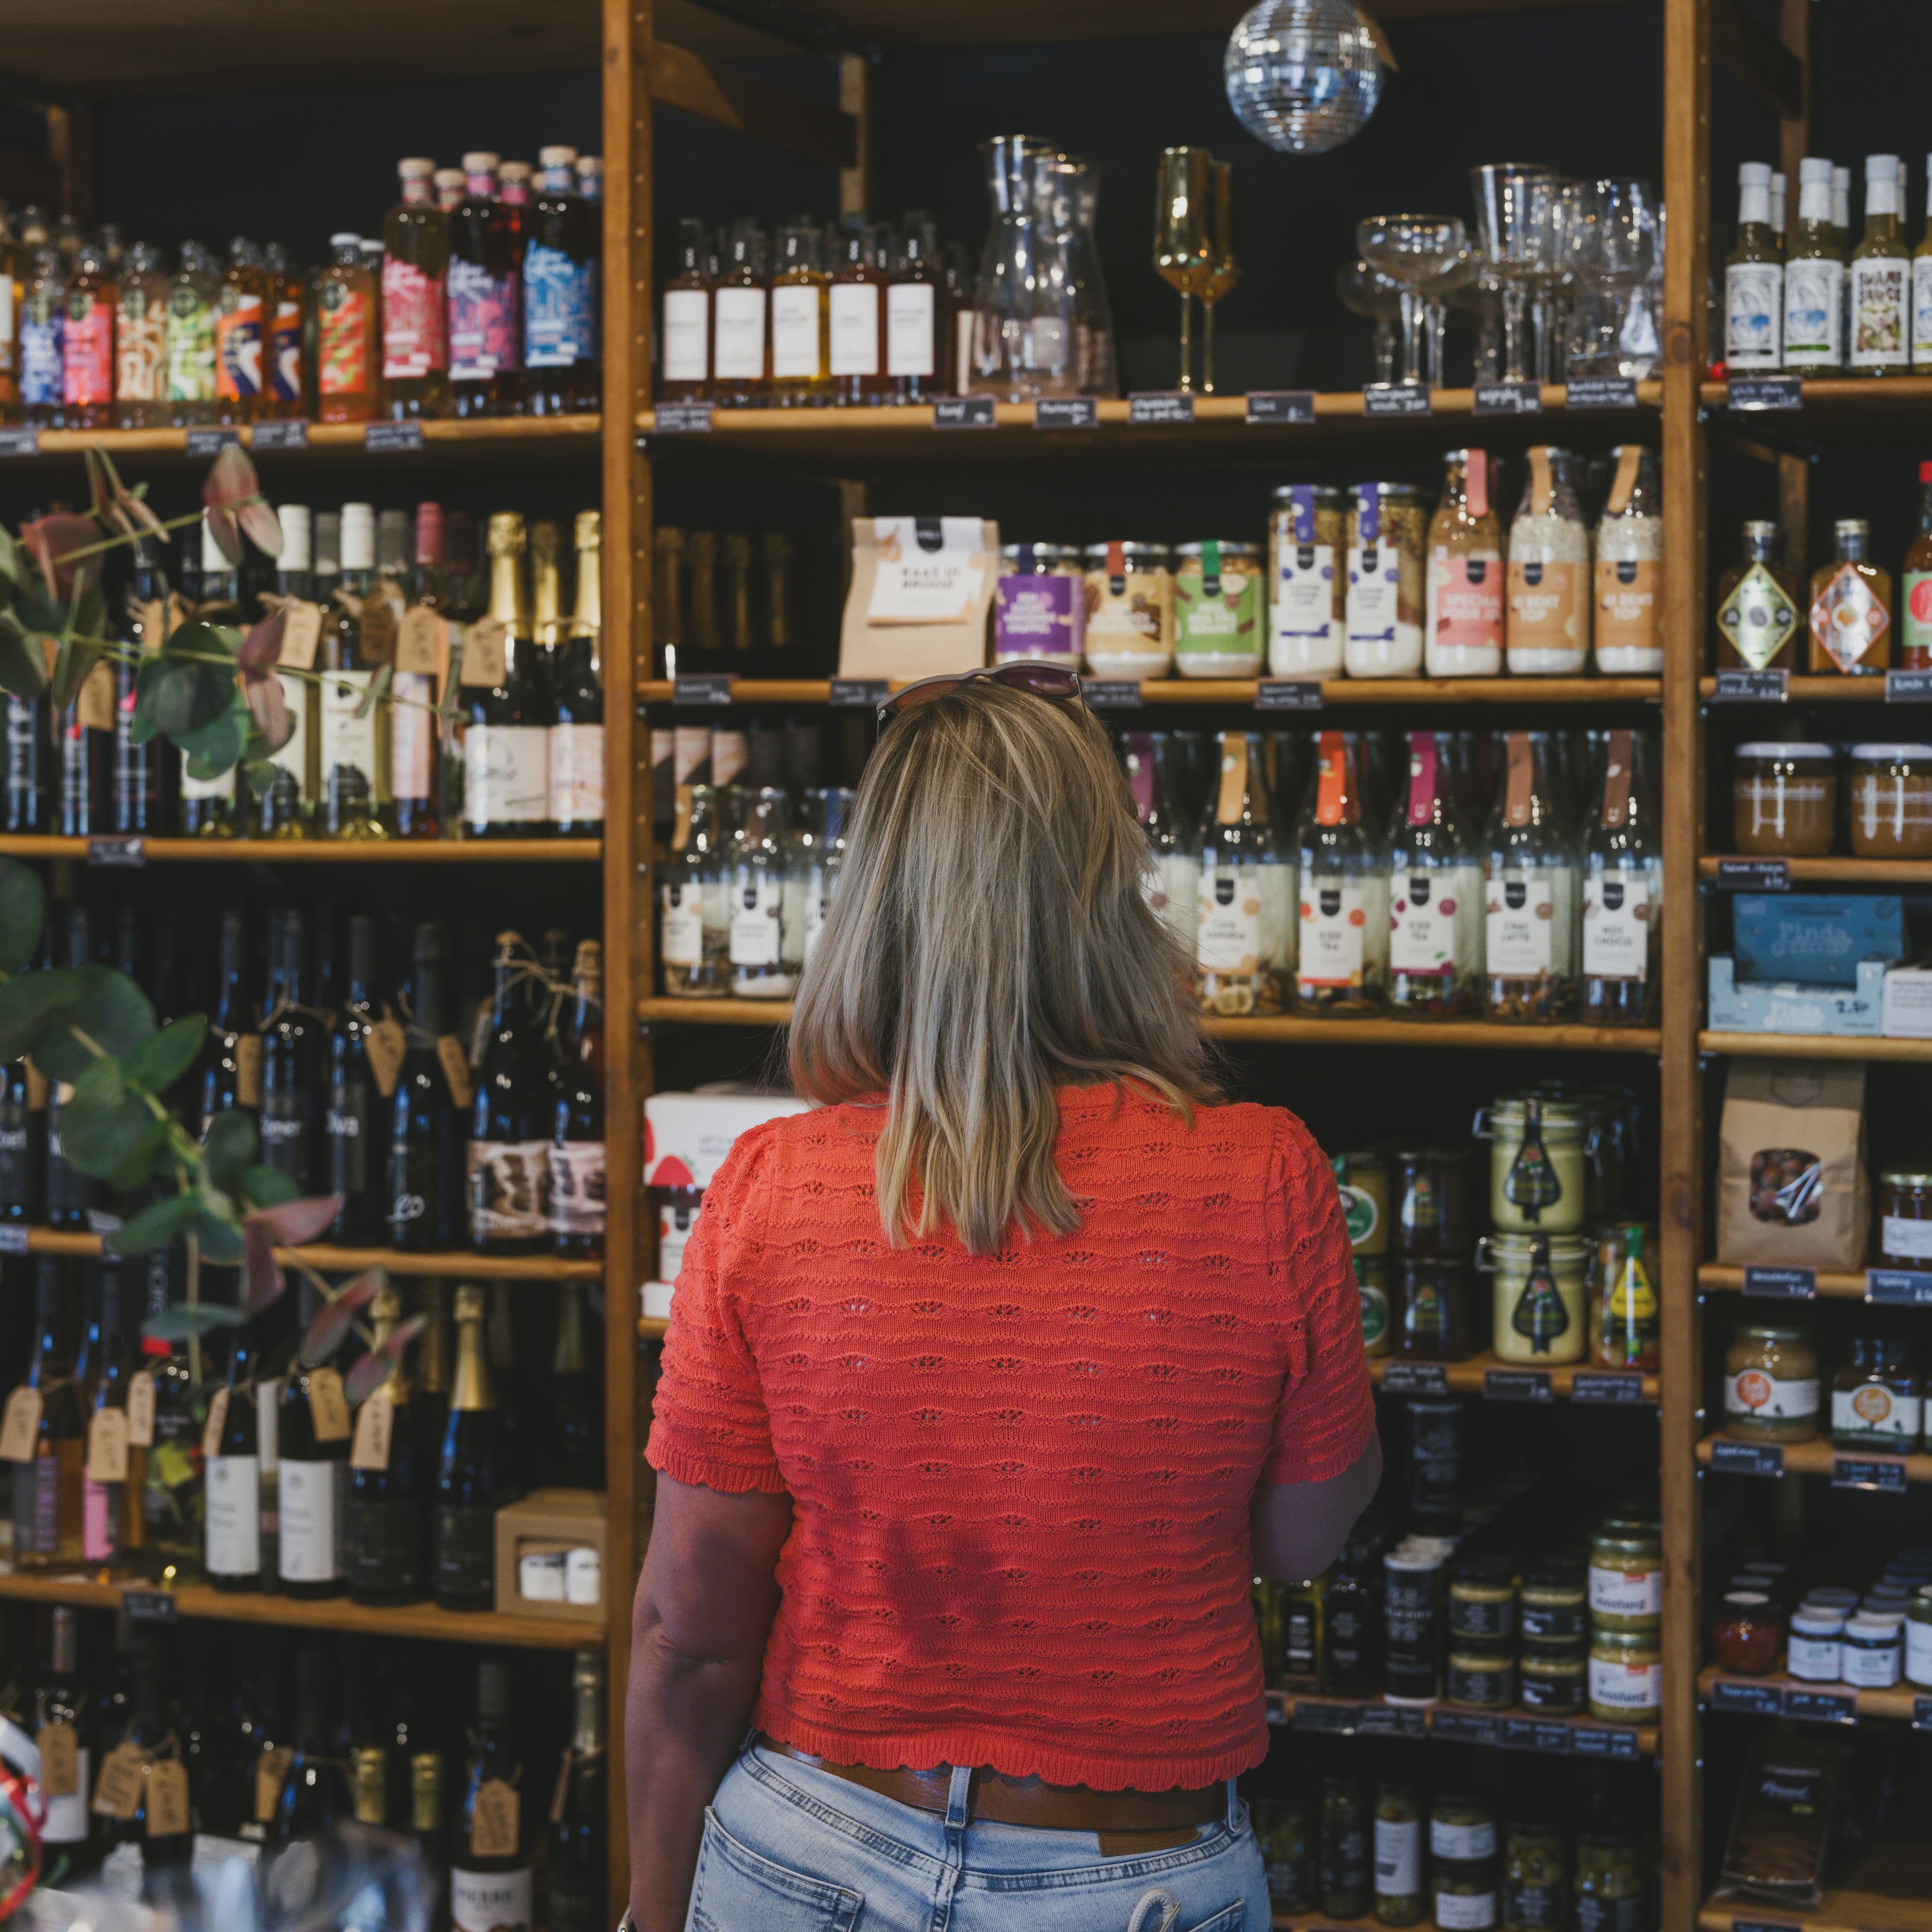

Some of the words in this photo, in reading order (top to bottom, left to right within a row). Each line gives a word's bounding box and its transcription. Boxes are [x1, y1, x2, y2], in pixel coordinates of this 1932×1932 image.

[1520, 609, 1547, 621] TOP
[1614, 607, 1641, 619] TOP
[1407, 921, 1432, 930] ICED
[1318, 931, 1342, 940] ICED
[1410, 931, 1429, 941] TEA
[1501, 932, 1530, 942] LATTE
[1321, 941, 1339, 951] TEA
